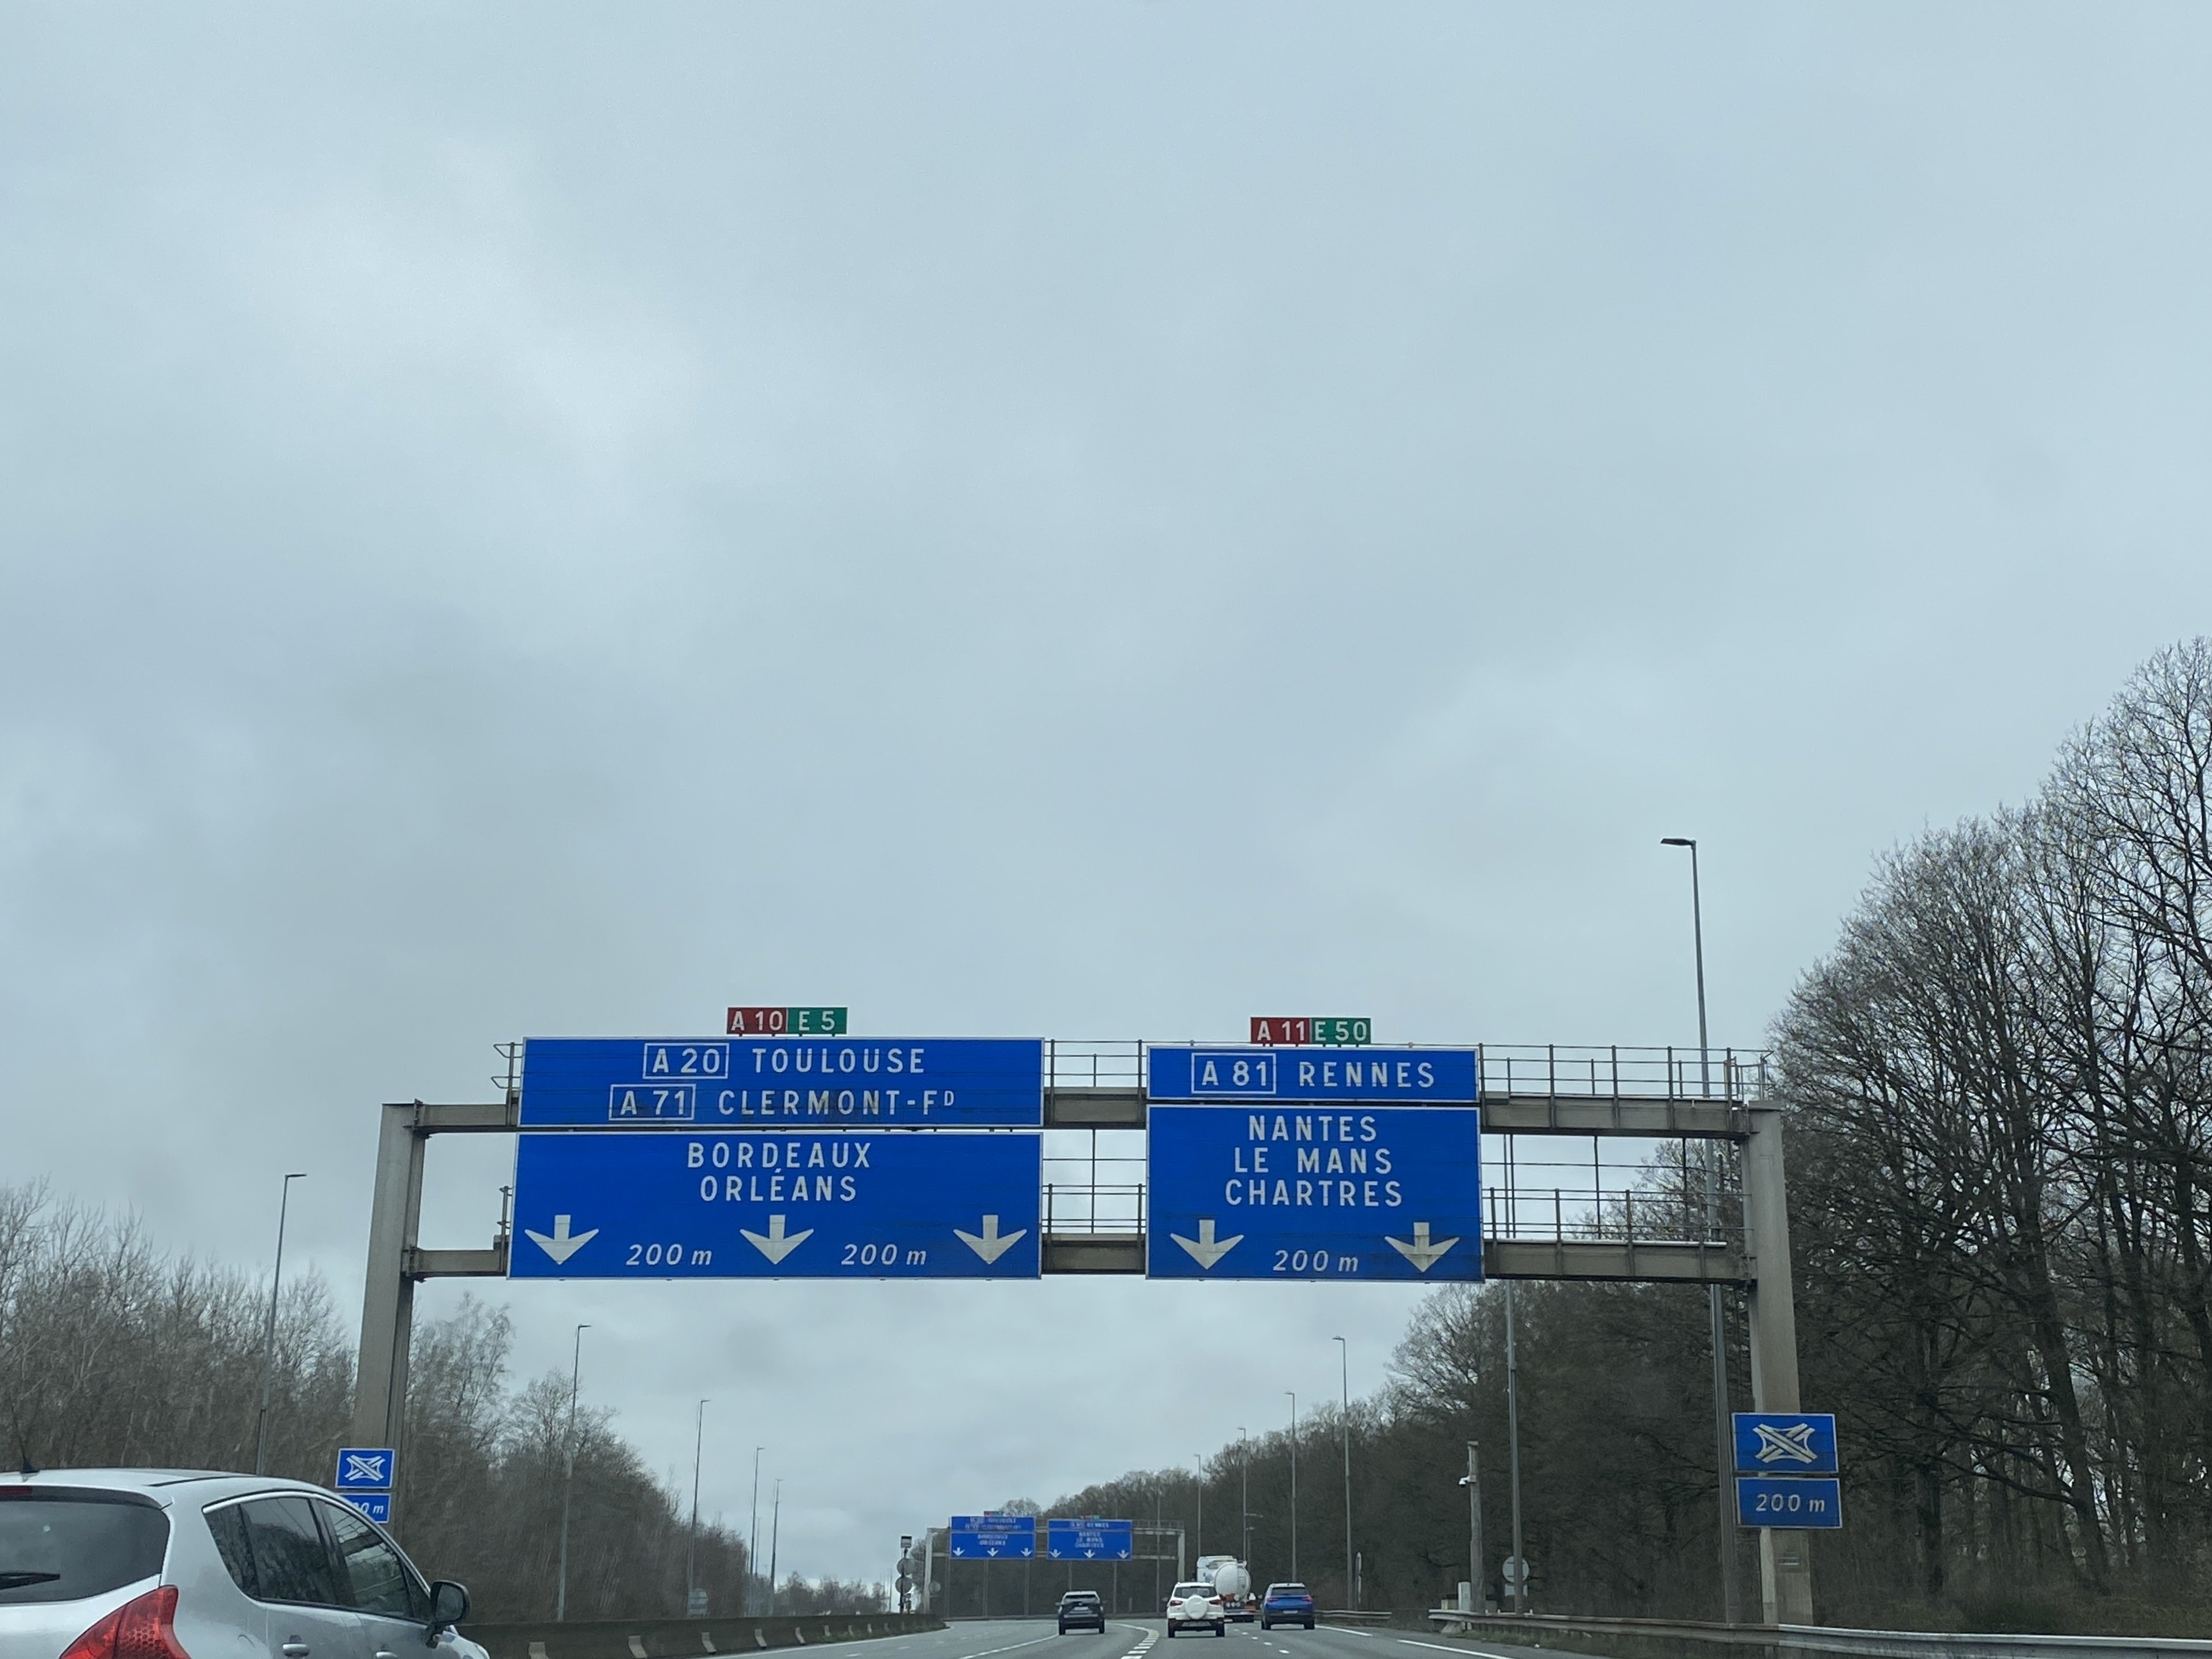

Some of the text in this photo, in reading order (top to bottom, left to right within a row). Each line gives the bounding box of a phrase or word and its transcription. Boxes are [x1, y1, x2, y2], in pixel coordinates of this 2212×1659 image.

[731, 1010, 783, 1031] A 10
[798, 1010, 835, 1031] E 5
[1257, 1020, 1304, 1041] A 11
[1315, 1021, 1367, 1042] E 50
[653, 1048, 924, 1073] A 20 TOULOUSE
[1202, 1061, 1434, 1088] A 81 RENNES
[620, 1091, 637, 1115] A
[653, 1090, 684, 1115] 71
[1249, 1115, 1377, 1142] NANTES
[688, 1142, 871, 1168] BORDEAUX
[1235, 1147, 1392, 1174] LE MANS
[700, 1168, 857, 1201] ORLÉANS
[1225, 1179, 1401, 1207] CHARTRES
[626, 1244, 712, 1265] 200 m
[841, 1244, 927, 1265] 200 m
[1273, 1250, 1358, 1272] 200 m
[1756, 1493, 1825, 1512] 200 m
